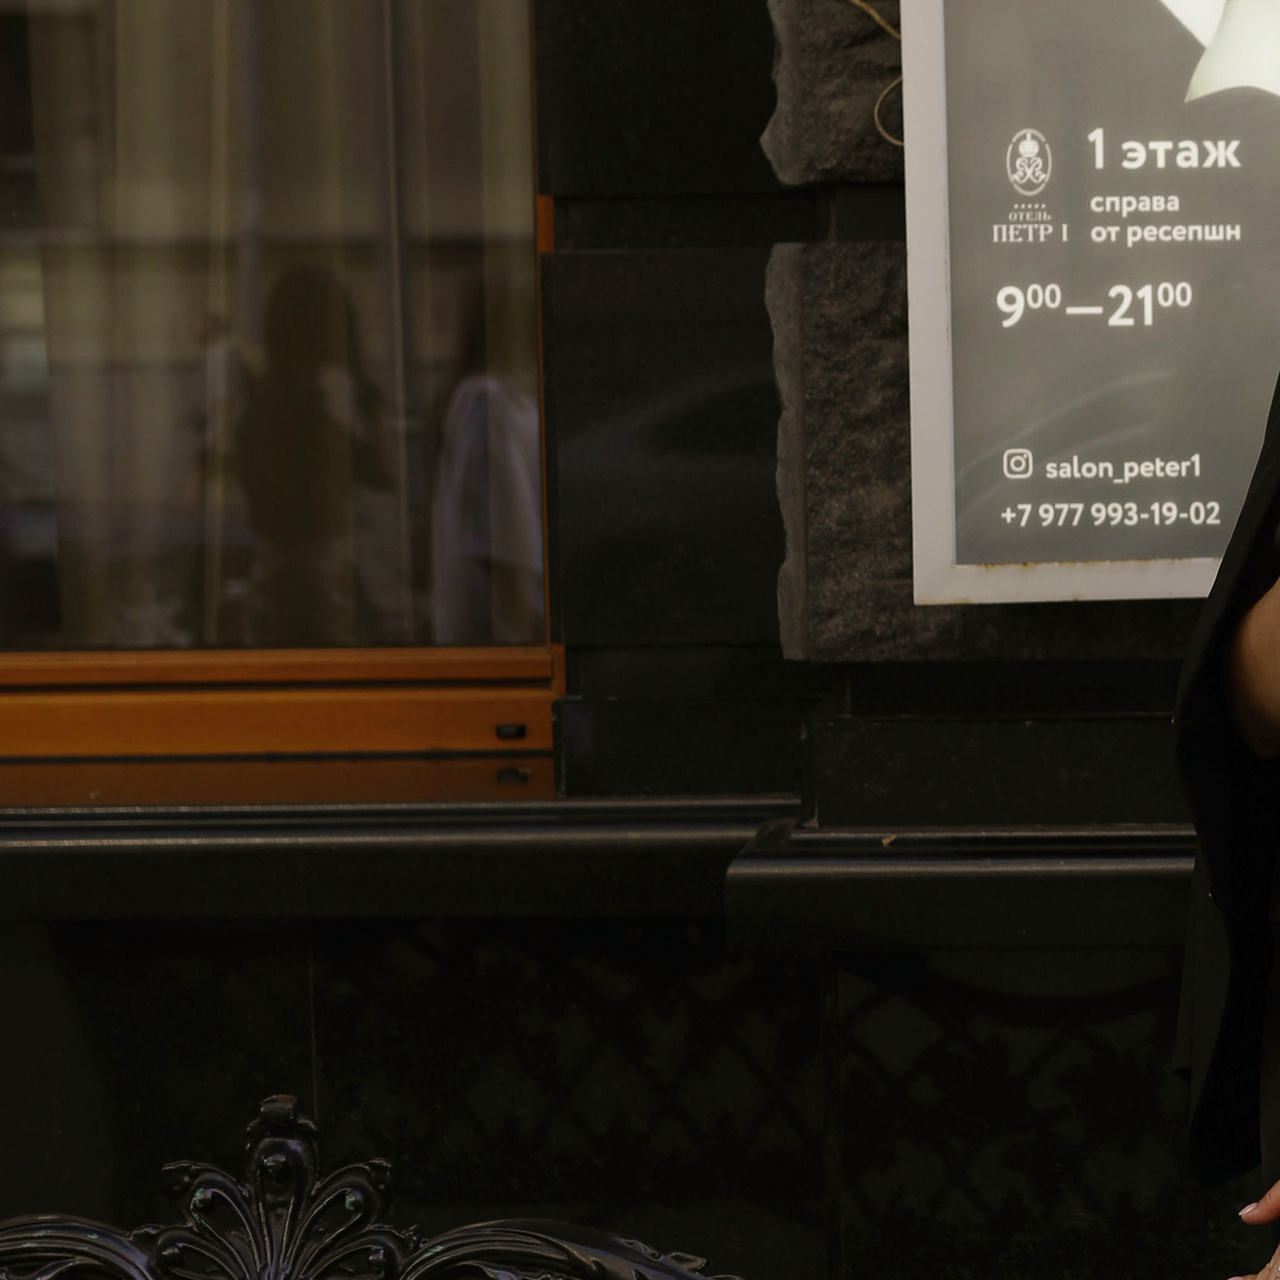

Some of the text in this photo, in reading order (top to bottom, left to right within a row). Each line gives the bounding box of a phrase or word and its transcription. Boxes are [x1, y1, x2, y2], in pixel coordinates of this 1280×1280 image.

[1088, 128, 1240, 169] 1 этаж
[1091, 196, 1179, 217] справа
[994, 224, 1053, 242] ПЕТР
[1091, 225, 1240, 247] от ресепшн
[1046, 454, 1200, 483] salon_peter1
[1001, 502, 1220, 526] +7 977 993-19-02
